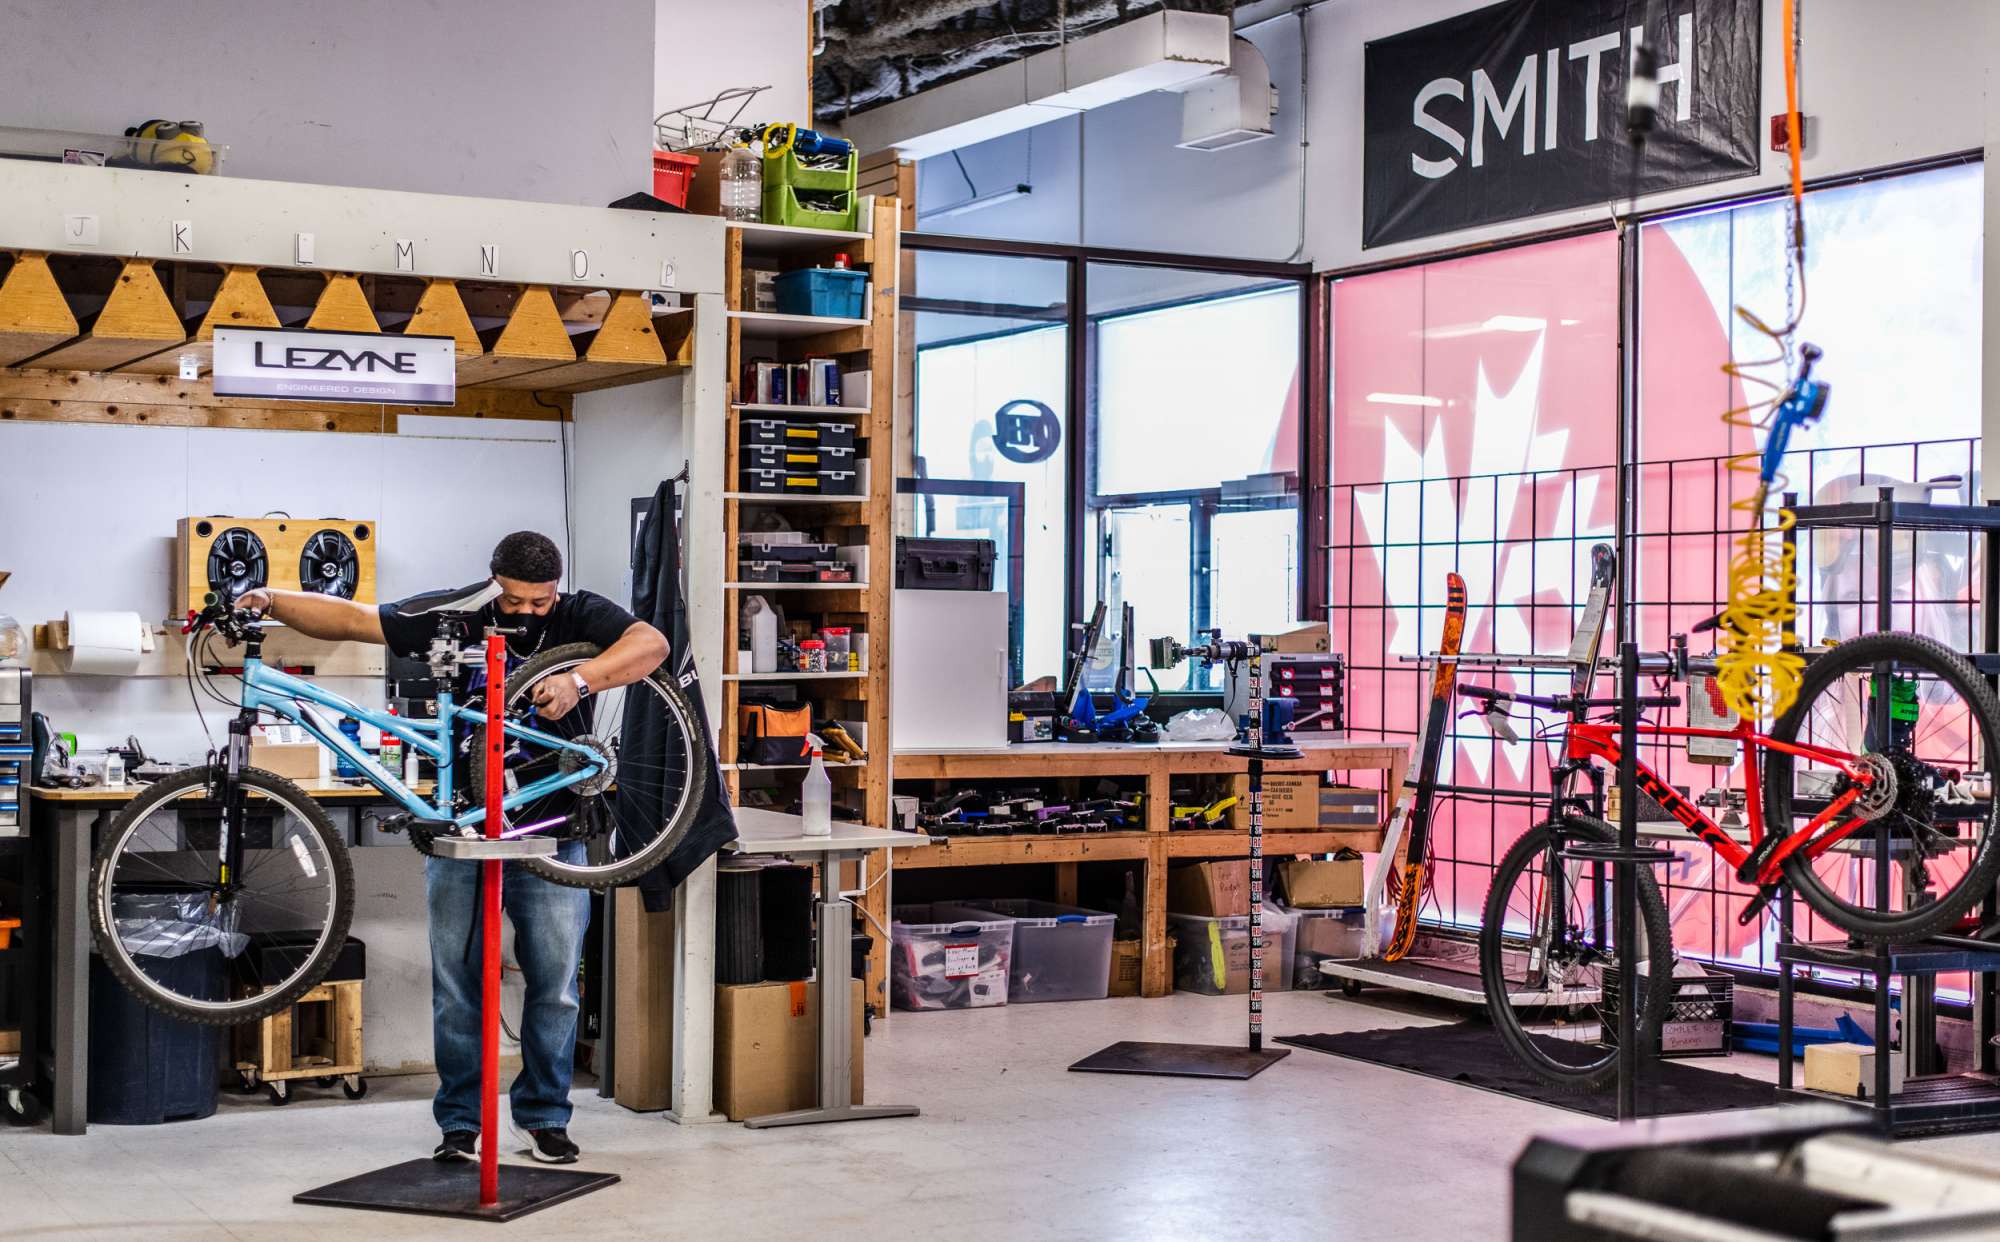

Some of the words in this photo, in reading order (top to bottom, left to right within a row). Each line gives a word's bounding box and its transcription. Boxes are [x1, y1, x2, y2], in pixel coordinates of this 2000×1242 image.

[1412, 12, 1693, 179] SMITH
[72, 216, 91, 237] J
[175, 223, 191, 253] K
[396, 241, 414, 271] M
[481, 246, 494, 275] N
[255, 341, 417, 374] LEZYNE
[276, 383, 350, 394] ENGINEERED
[353, 386, 397, 395] DESIGN
[1637, 766, 1728, 846] REK
